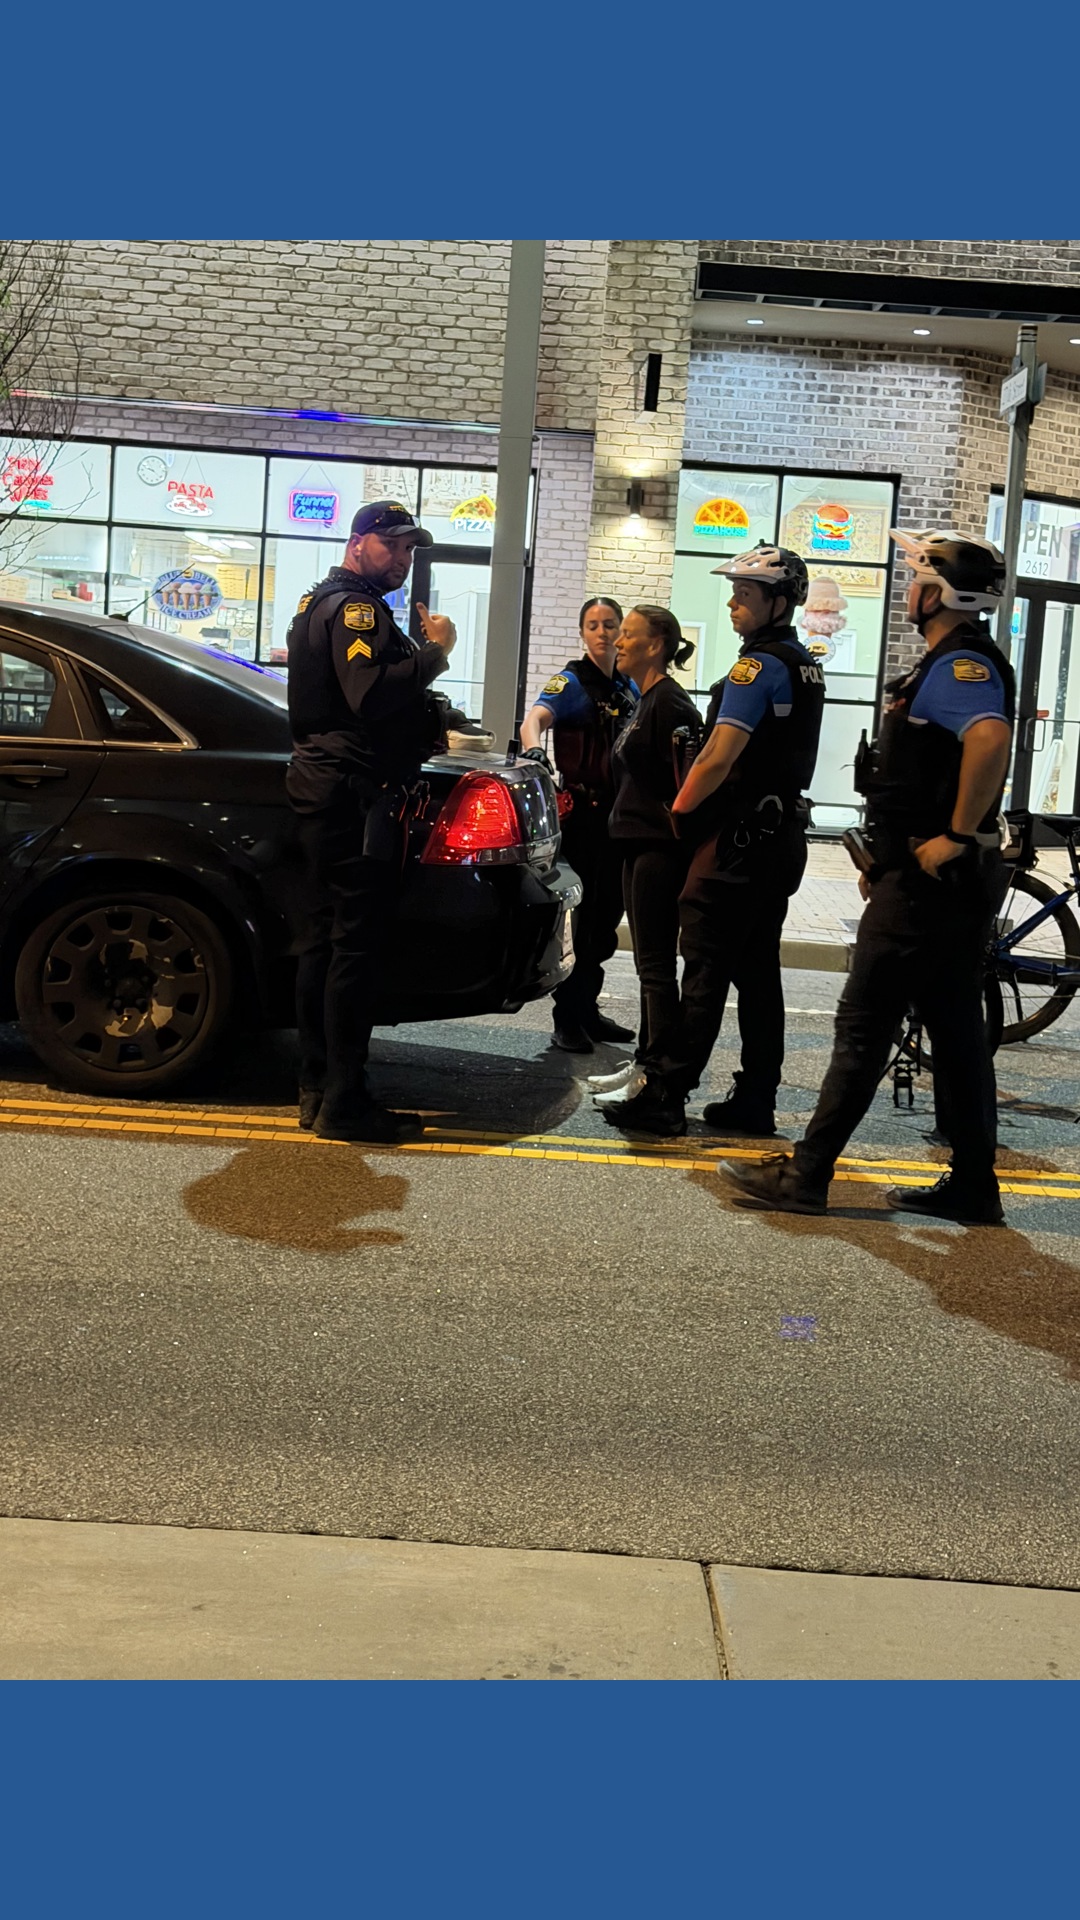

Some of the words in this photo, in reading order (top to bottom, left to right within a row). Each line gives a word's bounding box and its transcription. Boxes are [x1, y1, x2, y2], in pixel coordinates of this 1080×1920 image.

[168, 481, 214, 498] PASTA
[293, 493, 335, 508] Funnel
[294, 506, 333, 519] Cakes
[454, 518, 493, 532] PIZZA
[1023, 522, 1064, 558] PEN
[1025, 560, 1049, 576] 2612
[194, 571, 216, 585] BELL
[162, 605, 177, 617] ICE
[178, 608, 211, 619] CREAM
